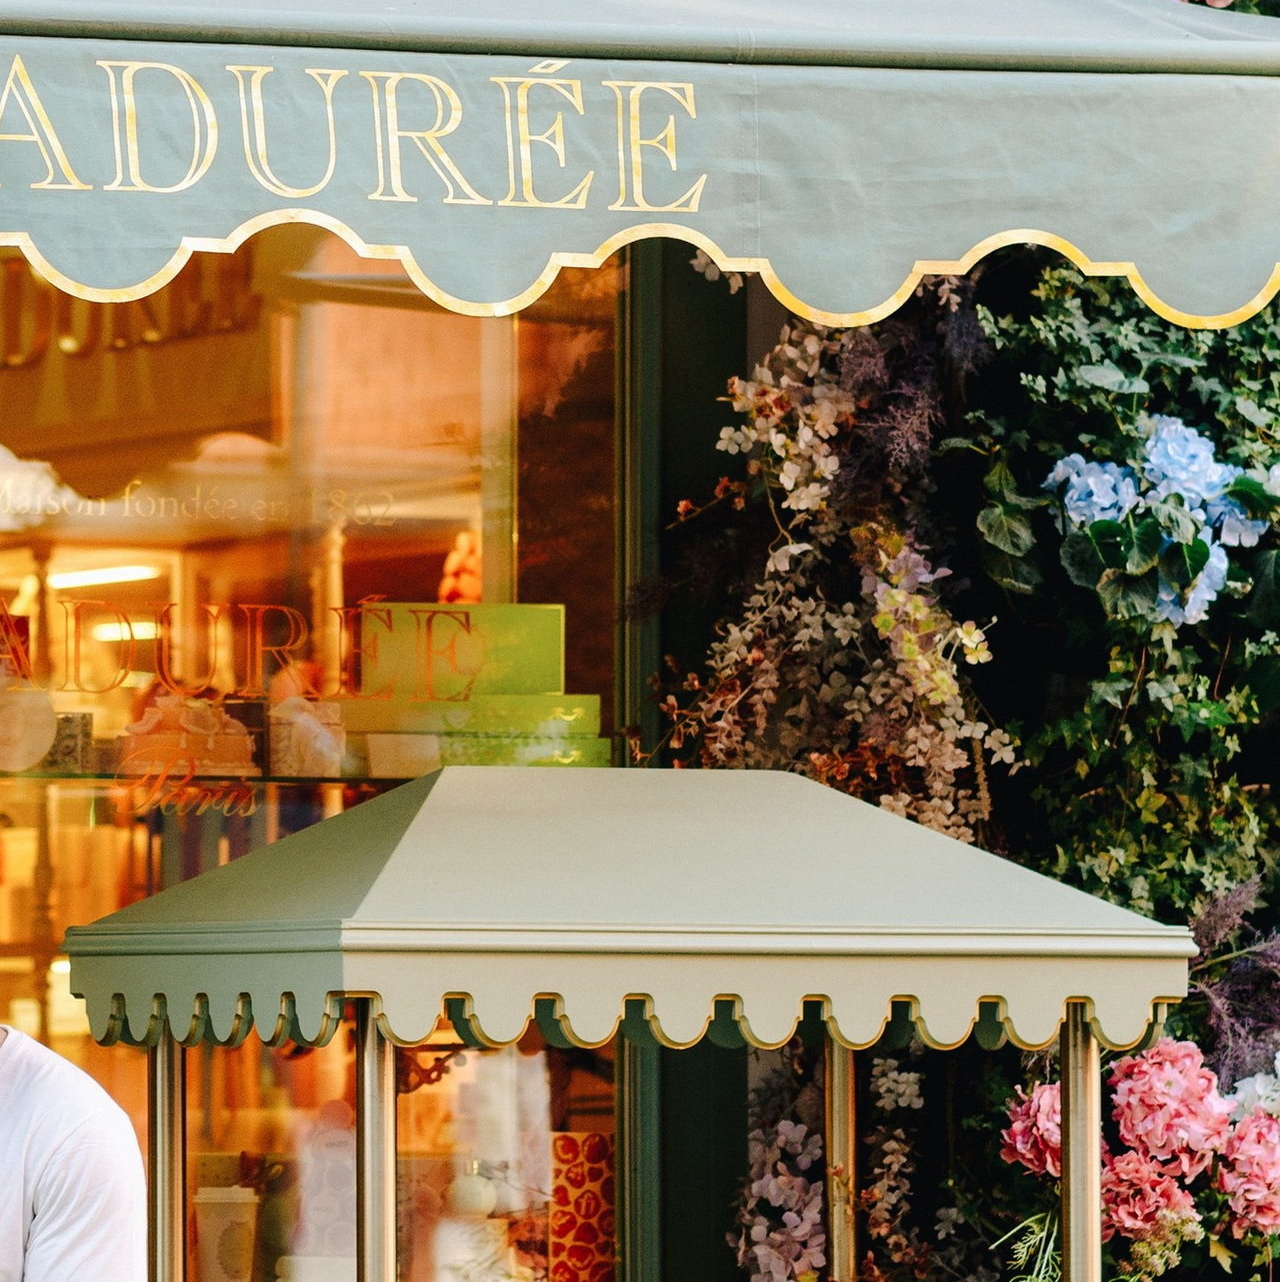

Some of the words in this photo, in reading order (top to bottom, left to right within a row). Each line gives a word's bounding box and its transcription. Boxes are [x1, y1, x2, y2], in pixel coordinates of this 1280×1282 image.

[121, 479, 239, 521] fondée
[250, 498, 288, 523] en
[308, 488, 397, 527] 1862
[113, 746, 266, 821] Paris
